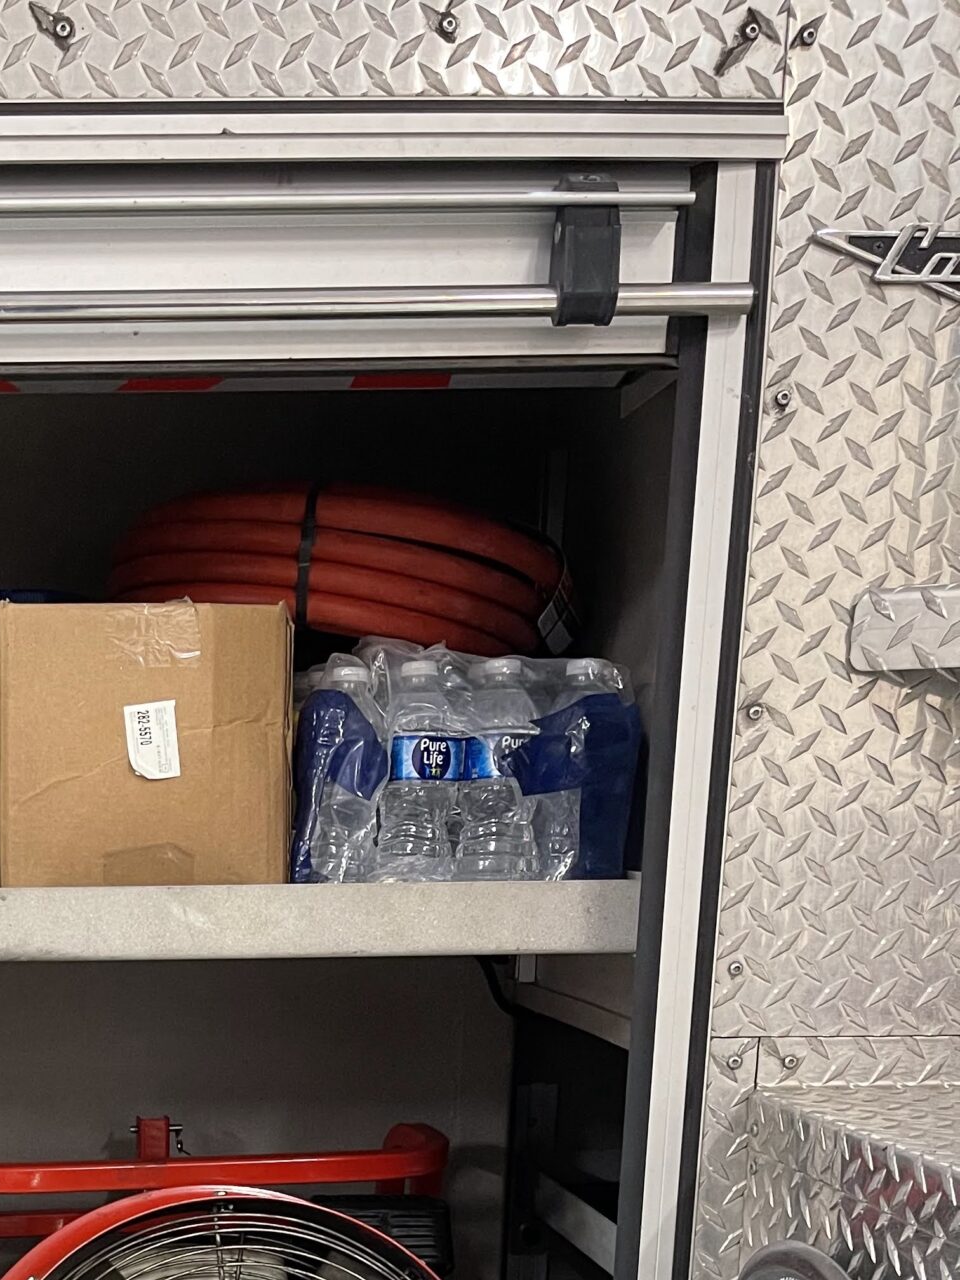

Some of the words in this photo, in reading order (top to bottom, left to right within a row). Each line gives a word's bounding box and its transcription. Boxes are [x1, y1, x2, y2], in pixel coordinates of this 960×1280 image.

[420, 738, 447, 752] Pure
[502, 735, 528, 749] Pur
[423, 751, 444, 767] Life
